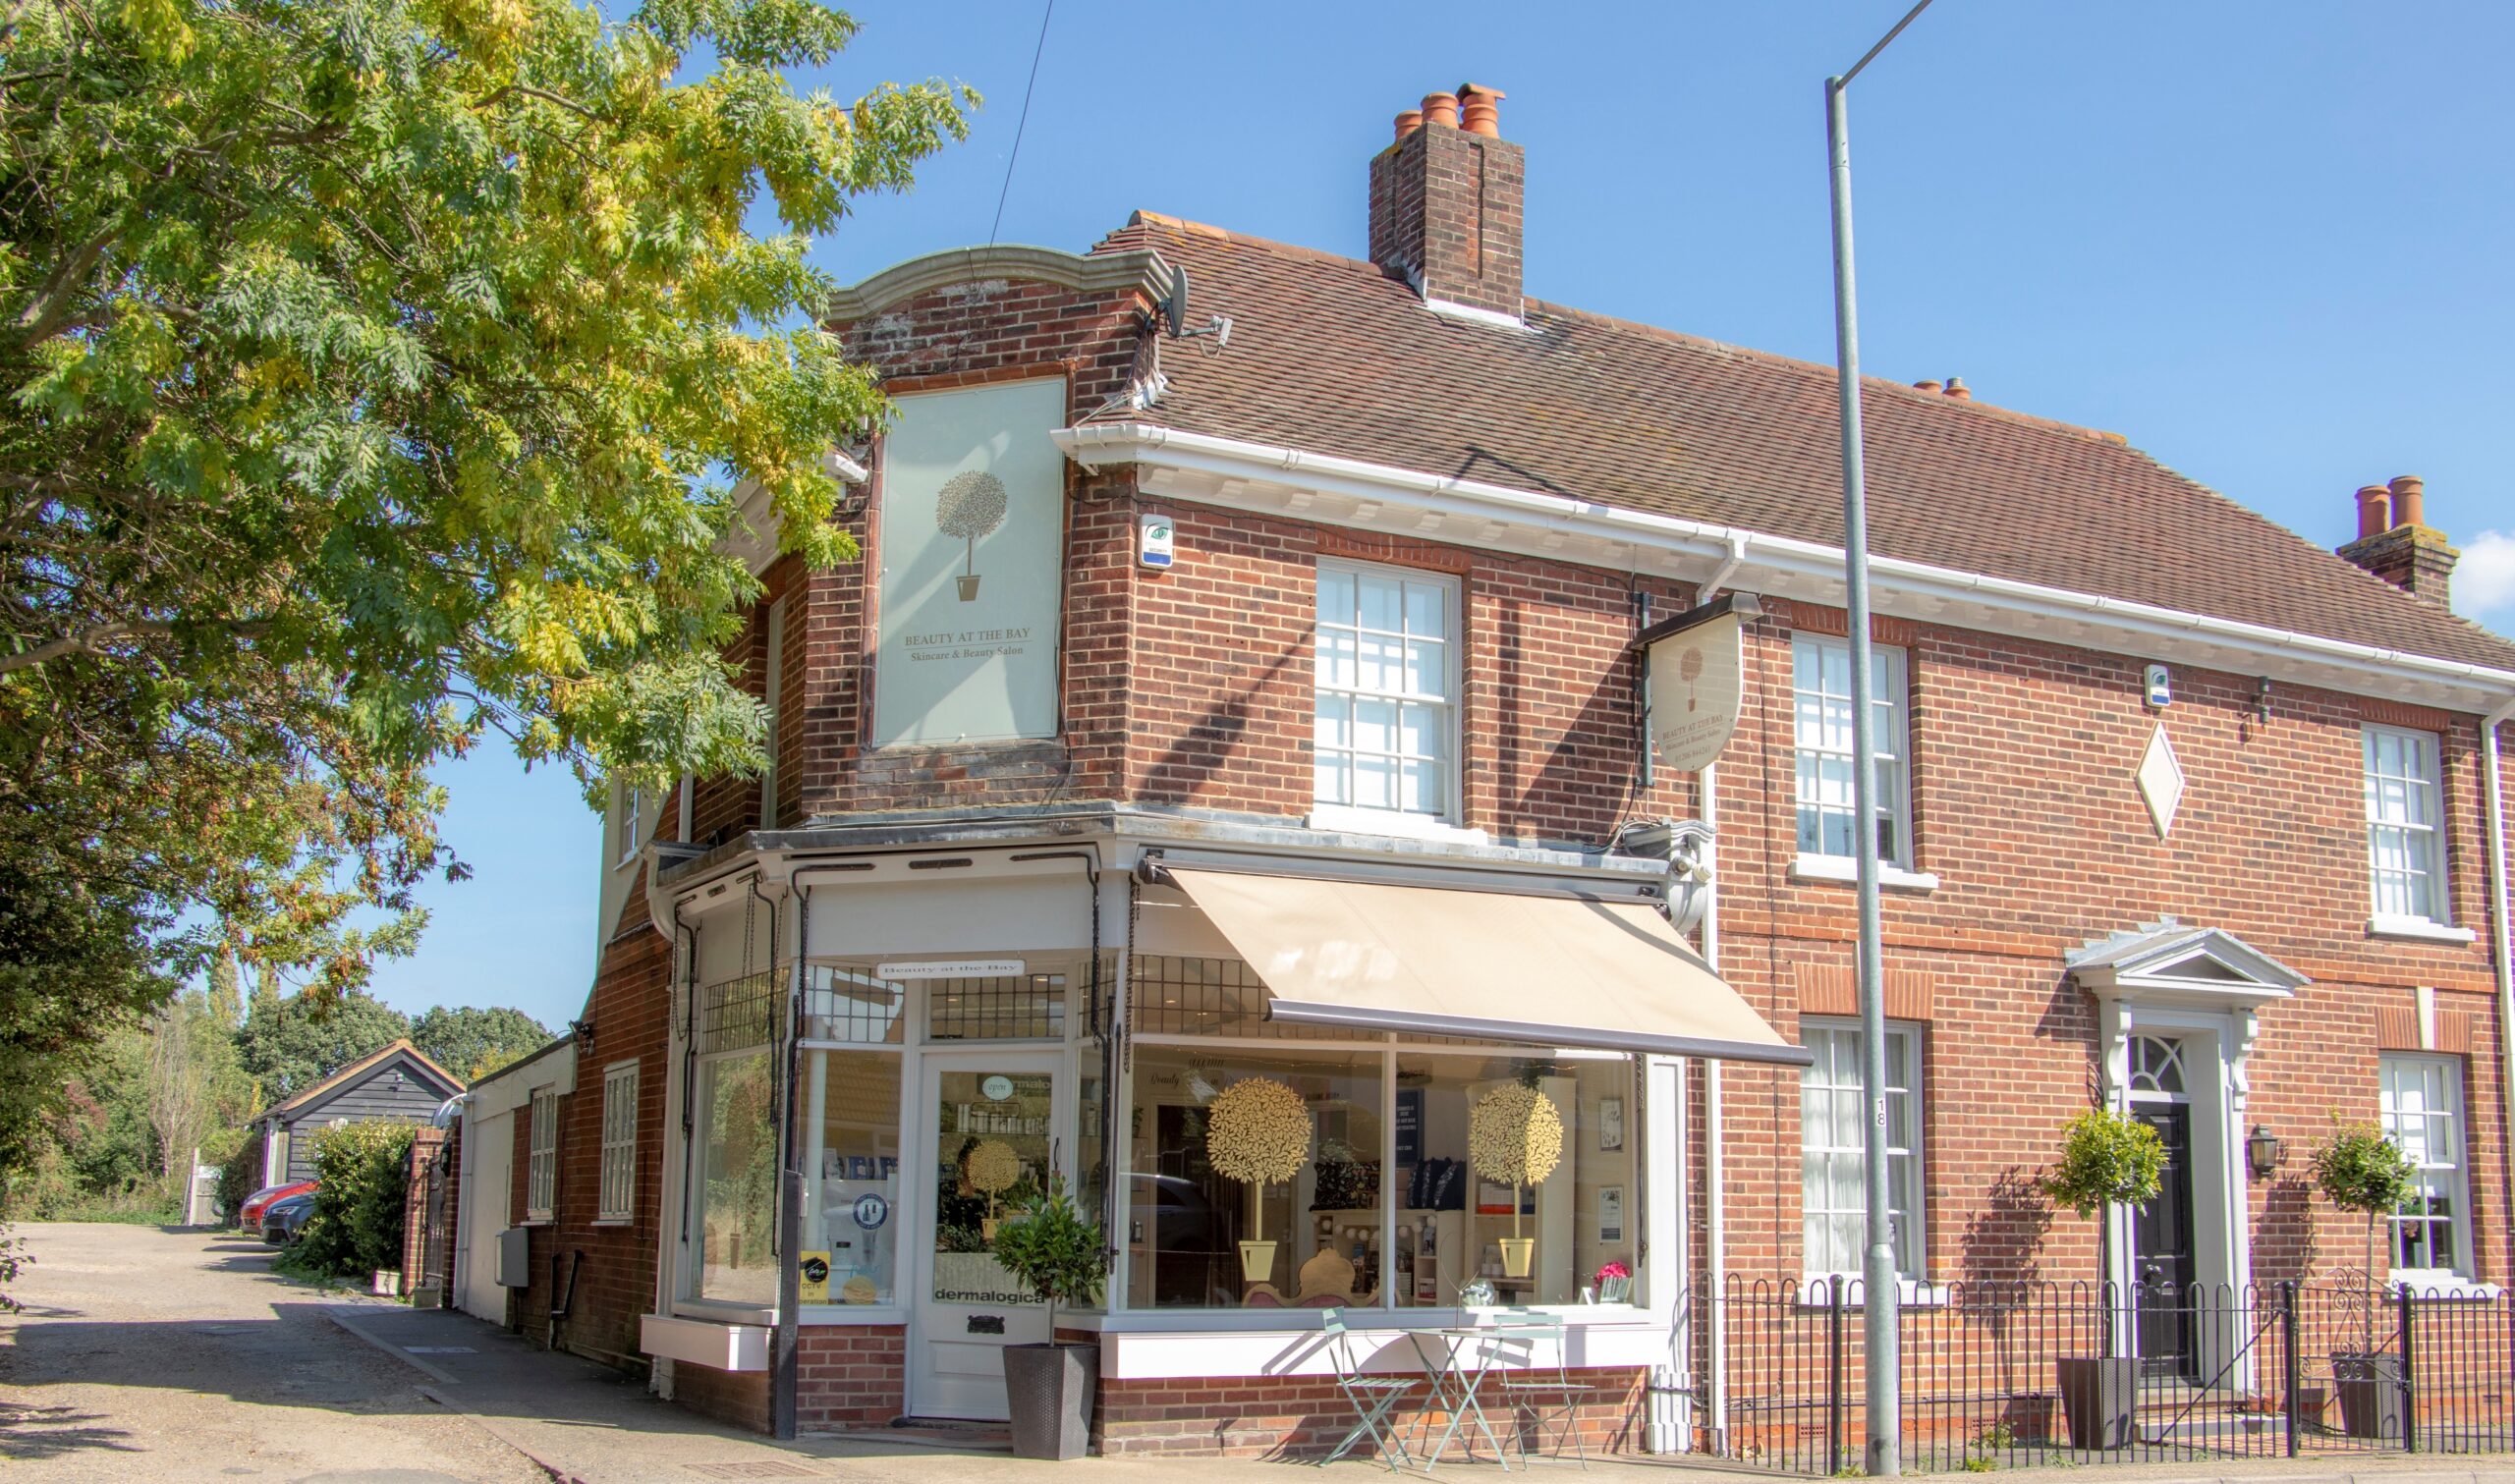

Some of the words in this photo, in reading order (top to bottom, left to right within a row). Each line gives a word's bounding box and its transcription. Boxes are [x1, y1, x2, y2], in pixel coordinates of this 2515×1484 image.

[905, 632, 955, 646] BEAUTY
[958, 632, 975, 642] AT
[978, 630, 1002, 640] THE
[1006, 628, 1031, 638] BAY
[911, 650, 950, 662] Skincare
[952, 650, 960, 659] &
[963, 648, 994, 659] Beauty
[997, 646, 1024, 656] Salon
[1662, 726, 1686, 741] BEAUTY
[1688, 722, 1697, 732] AT
[1698, 718, 1710, 729] THE
[1710, 714, 1723, 725] BAY
[988, 1083, 1007, 1093] open
[934, 1289, 1045, 1305] dermalogica
